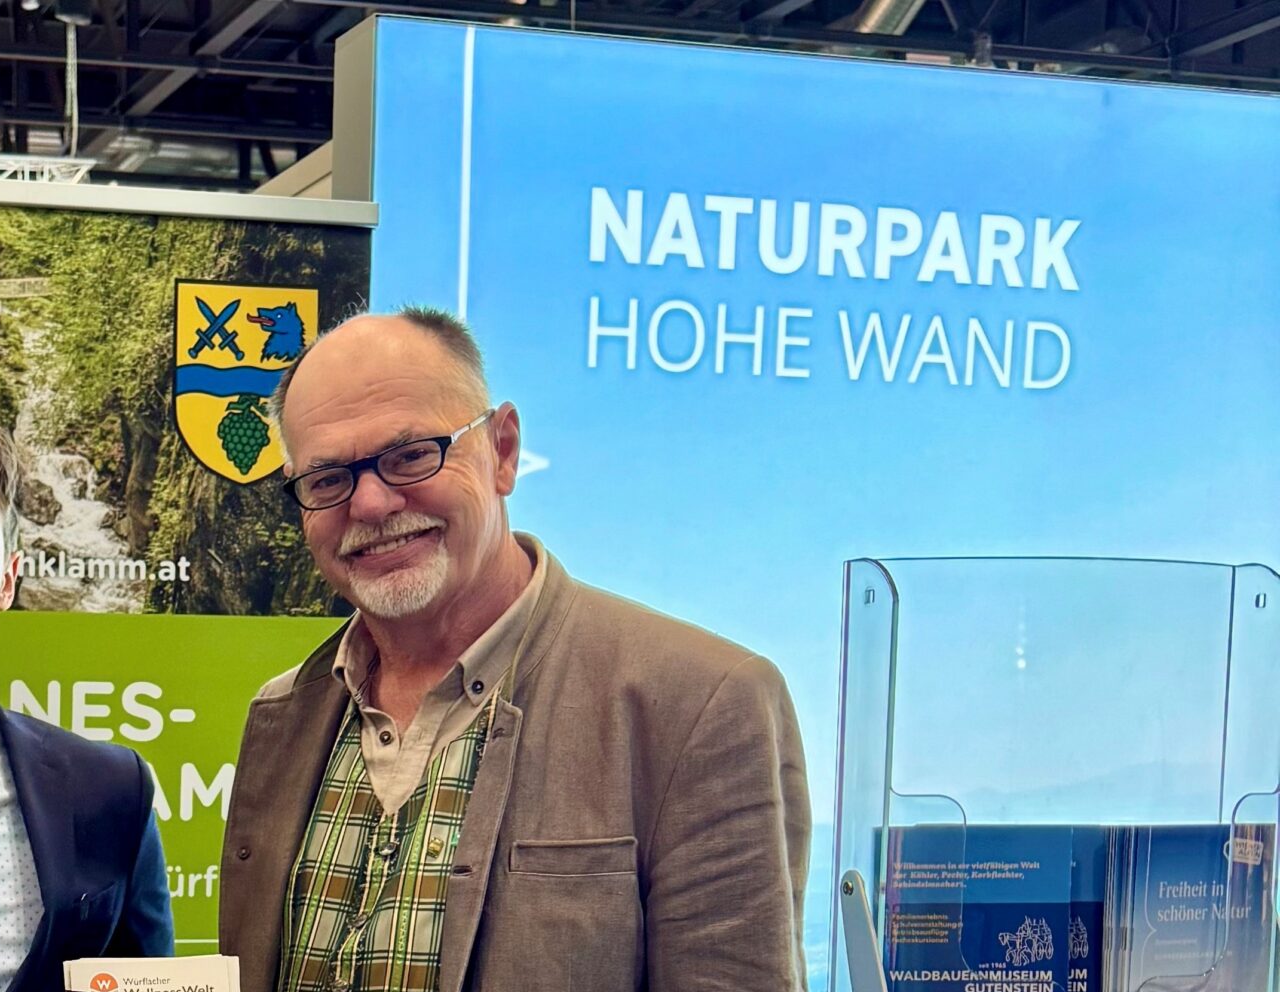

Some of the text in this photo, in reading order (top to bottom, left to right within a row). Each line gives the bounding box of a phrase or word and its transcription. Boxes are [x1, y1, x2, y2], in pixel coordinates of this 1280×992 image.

[589, 187, 1082, 291] NATURPARK
[588, 296, 1071, 389] HOHE WAND
[1158, 880, 1224, 899] Freiheit in
[1157, 904, 1208, 922] schöner
[889, 969, 1053, 982] WALDBAUERNMUSEUM
